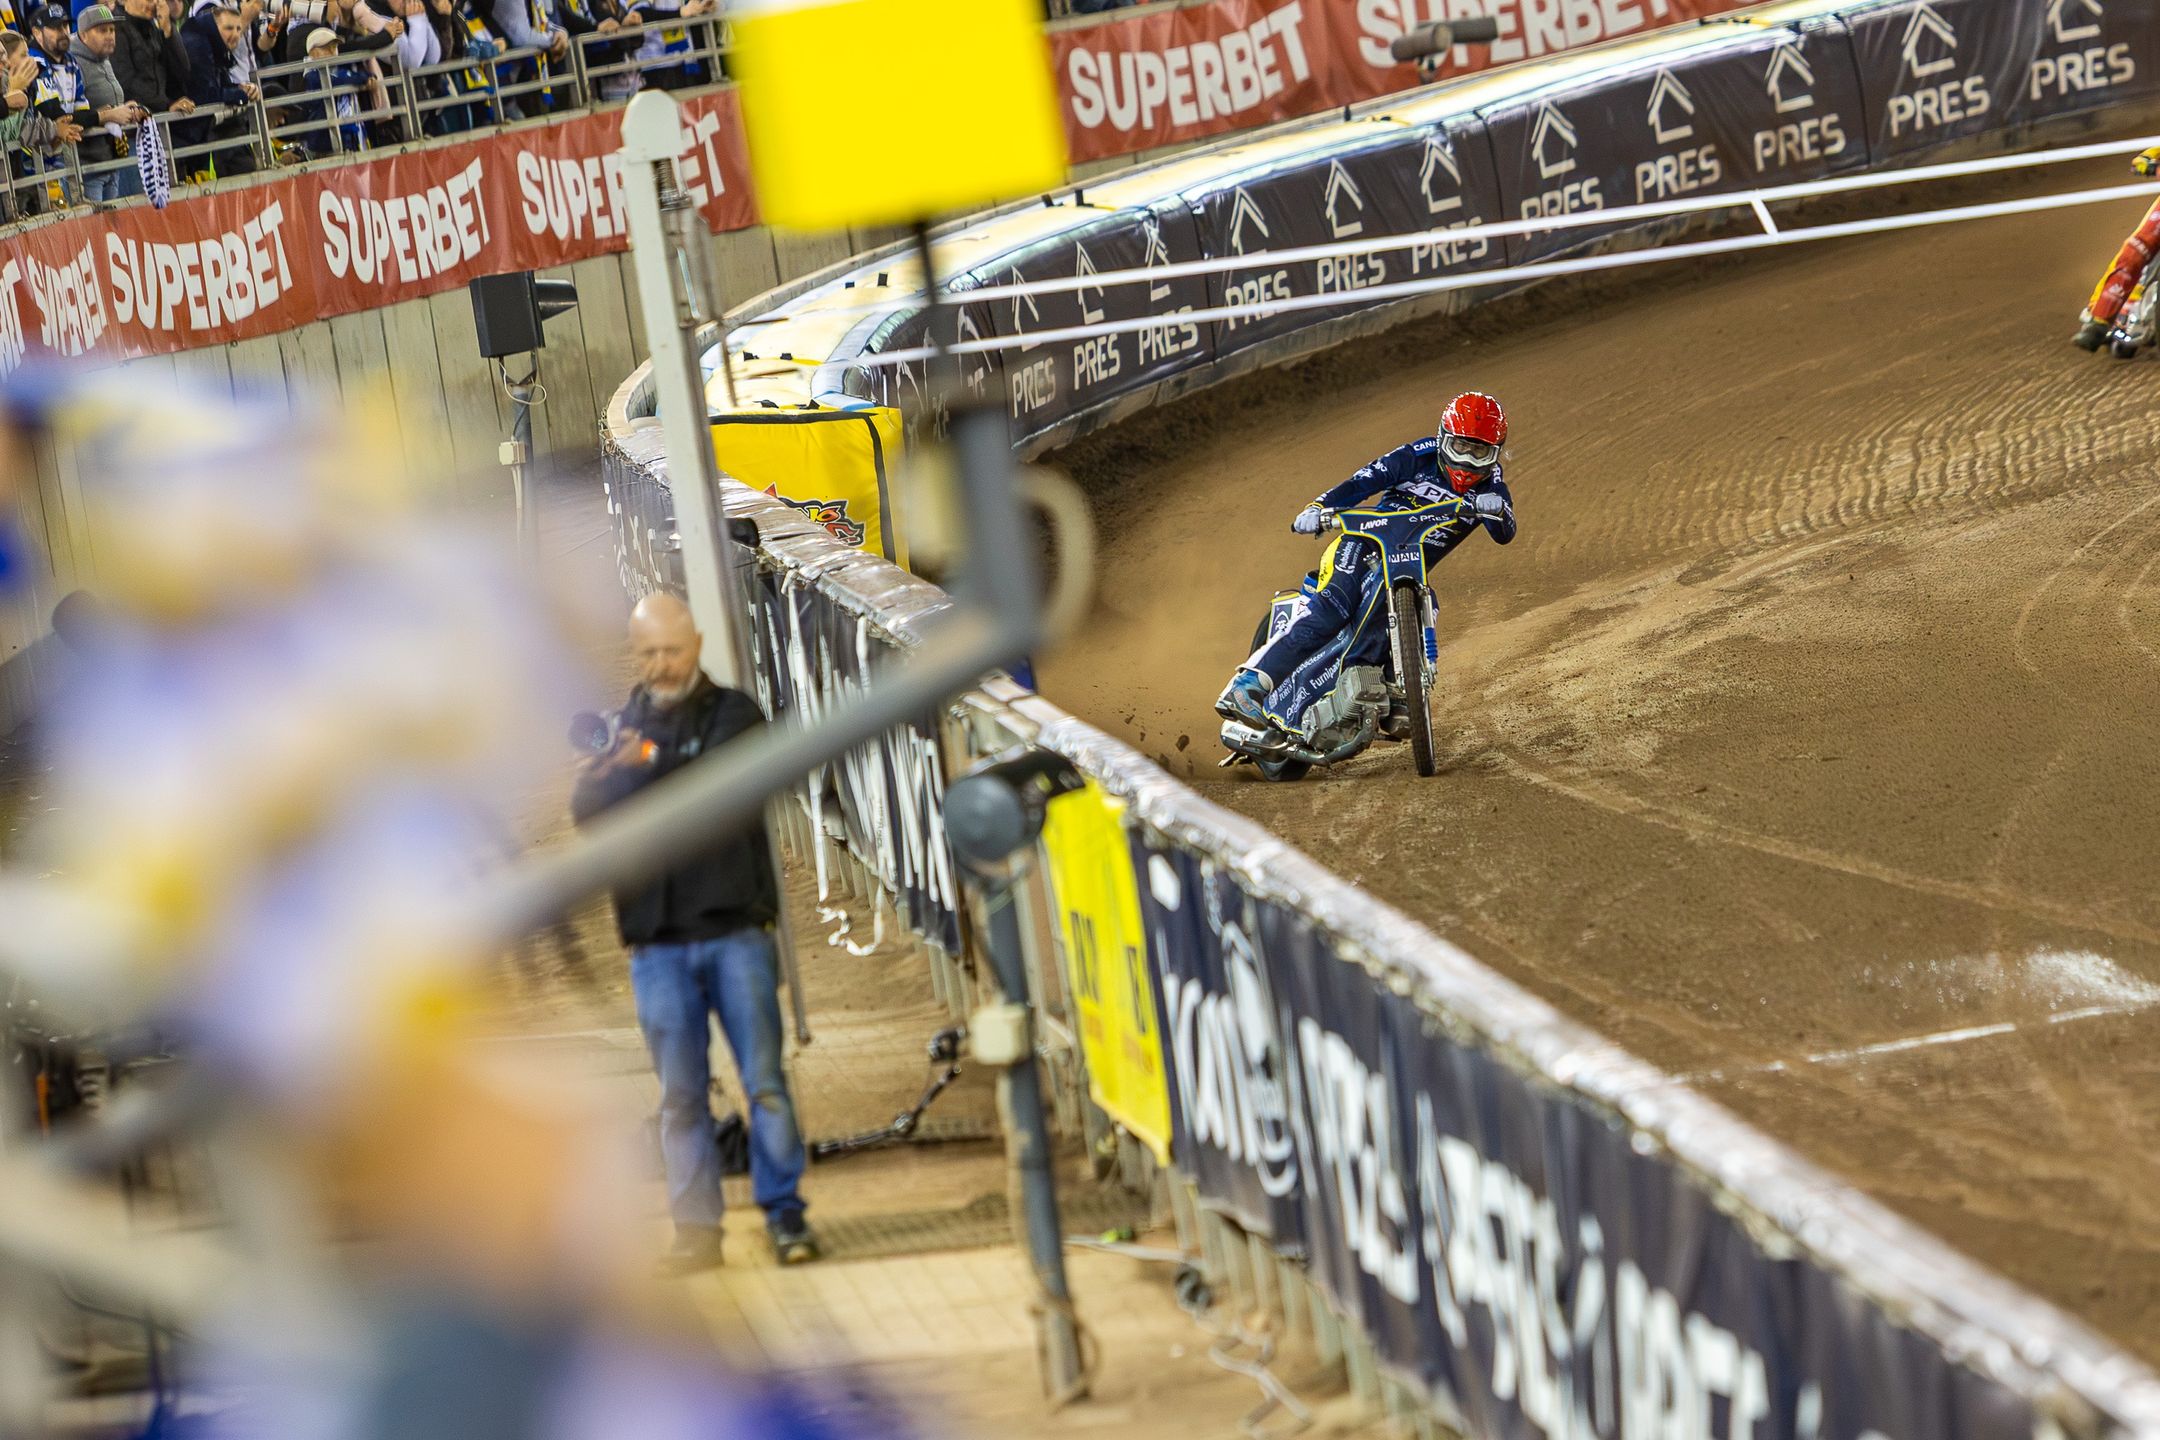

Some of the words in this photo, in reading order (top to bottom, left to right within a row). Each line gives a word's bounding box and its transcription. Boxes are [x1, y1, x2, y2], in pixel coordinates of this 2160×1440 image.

[1068, 0, 1309, 131] SUPERBET
[2030, 43, 2136, 100] PRES
[1888, 75, 1990, 138] PRES
[1754, 114, 1846, 173] PRES
[1635, 144, 1722, 205] PRES
[319, 156, 490, 284] SUPERBET
[105, 200, 293, 331] SUPERBET
[1317, 251, 1386, 294] PRES
[1225, 270, 1291, 331] PRES
[1012, 356, 1057, 419] PRES
[1073, 333, 1121, 391] PRES
[1359, 518, 1389, 531] LAVOR
